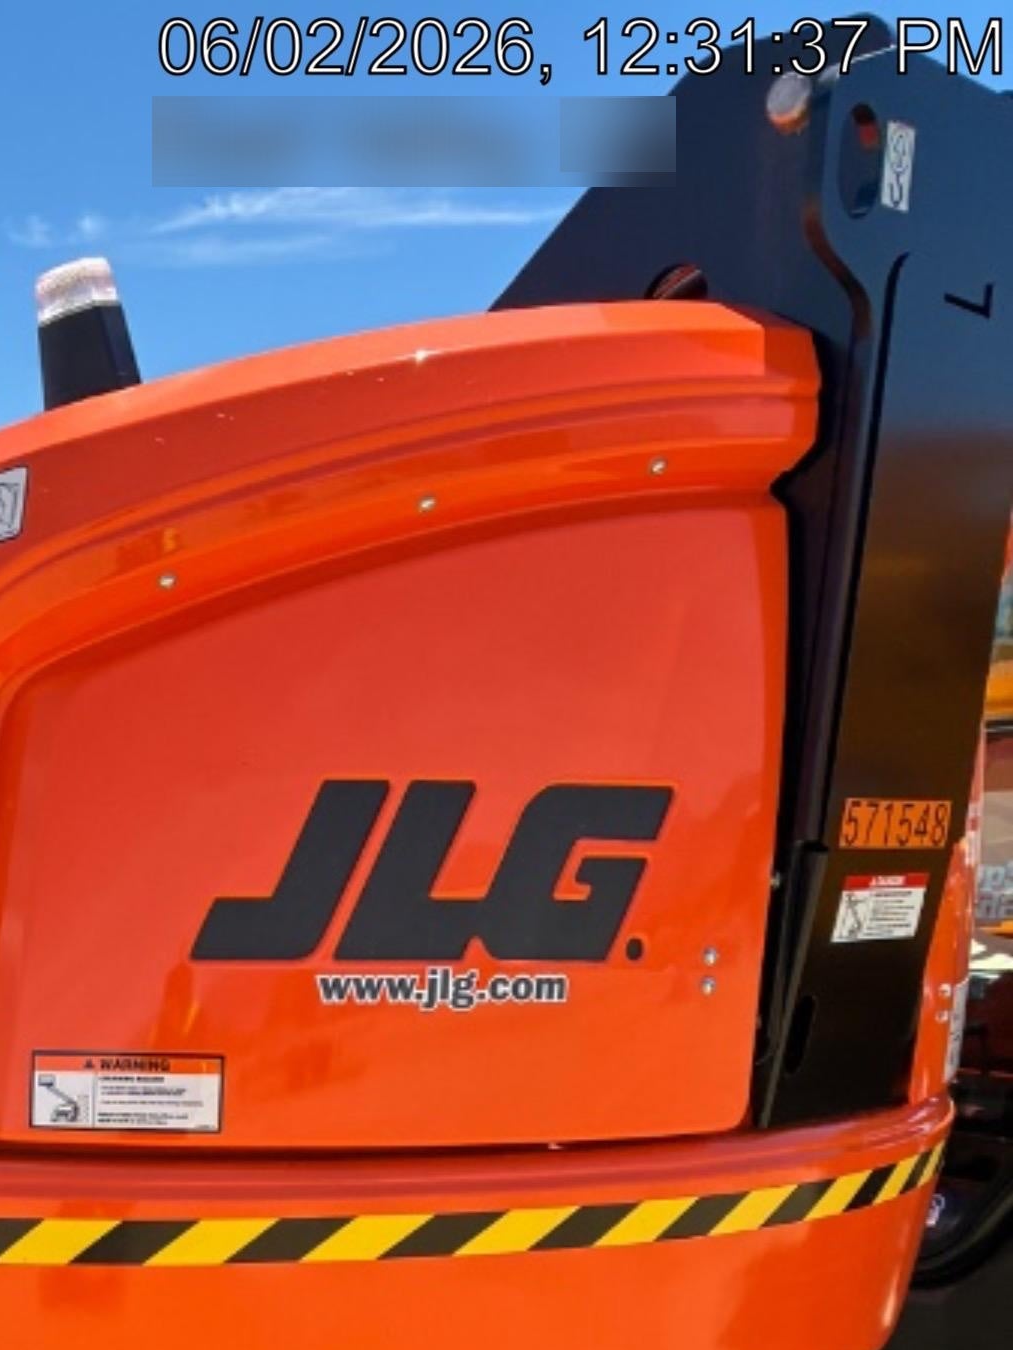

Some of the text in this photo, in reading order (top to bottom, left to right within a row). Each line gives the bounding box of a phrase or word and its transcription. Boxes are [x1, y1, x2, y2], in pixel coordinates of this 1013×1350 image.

[844, 800, 948, 845] 571548
[318, 968, 567, 1010] www.jlg.com
[99, 1058, 171, 1071] WARNING
